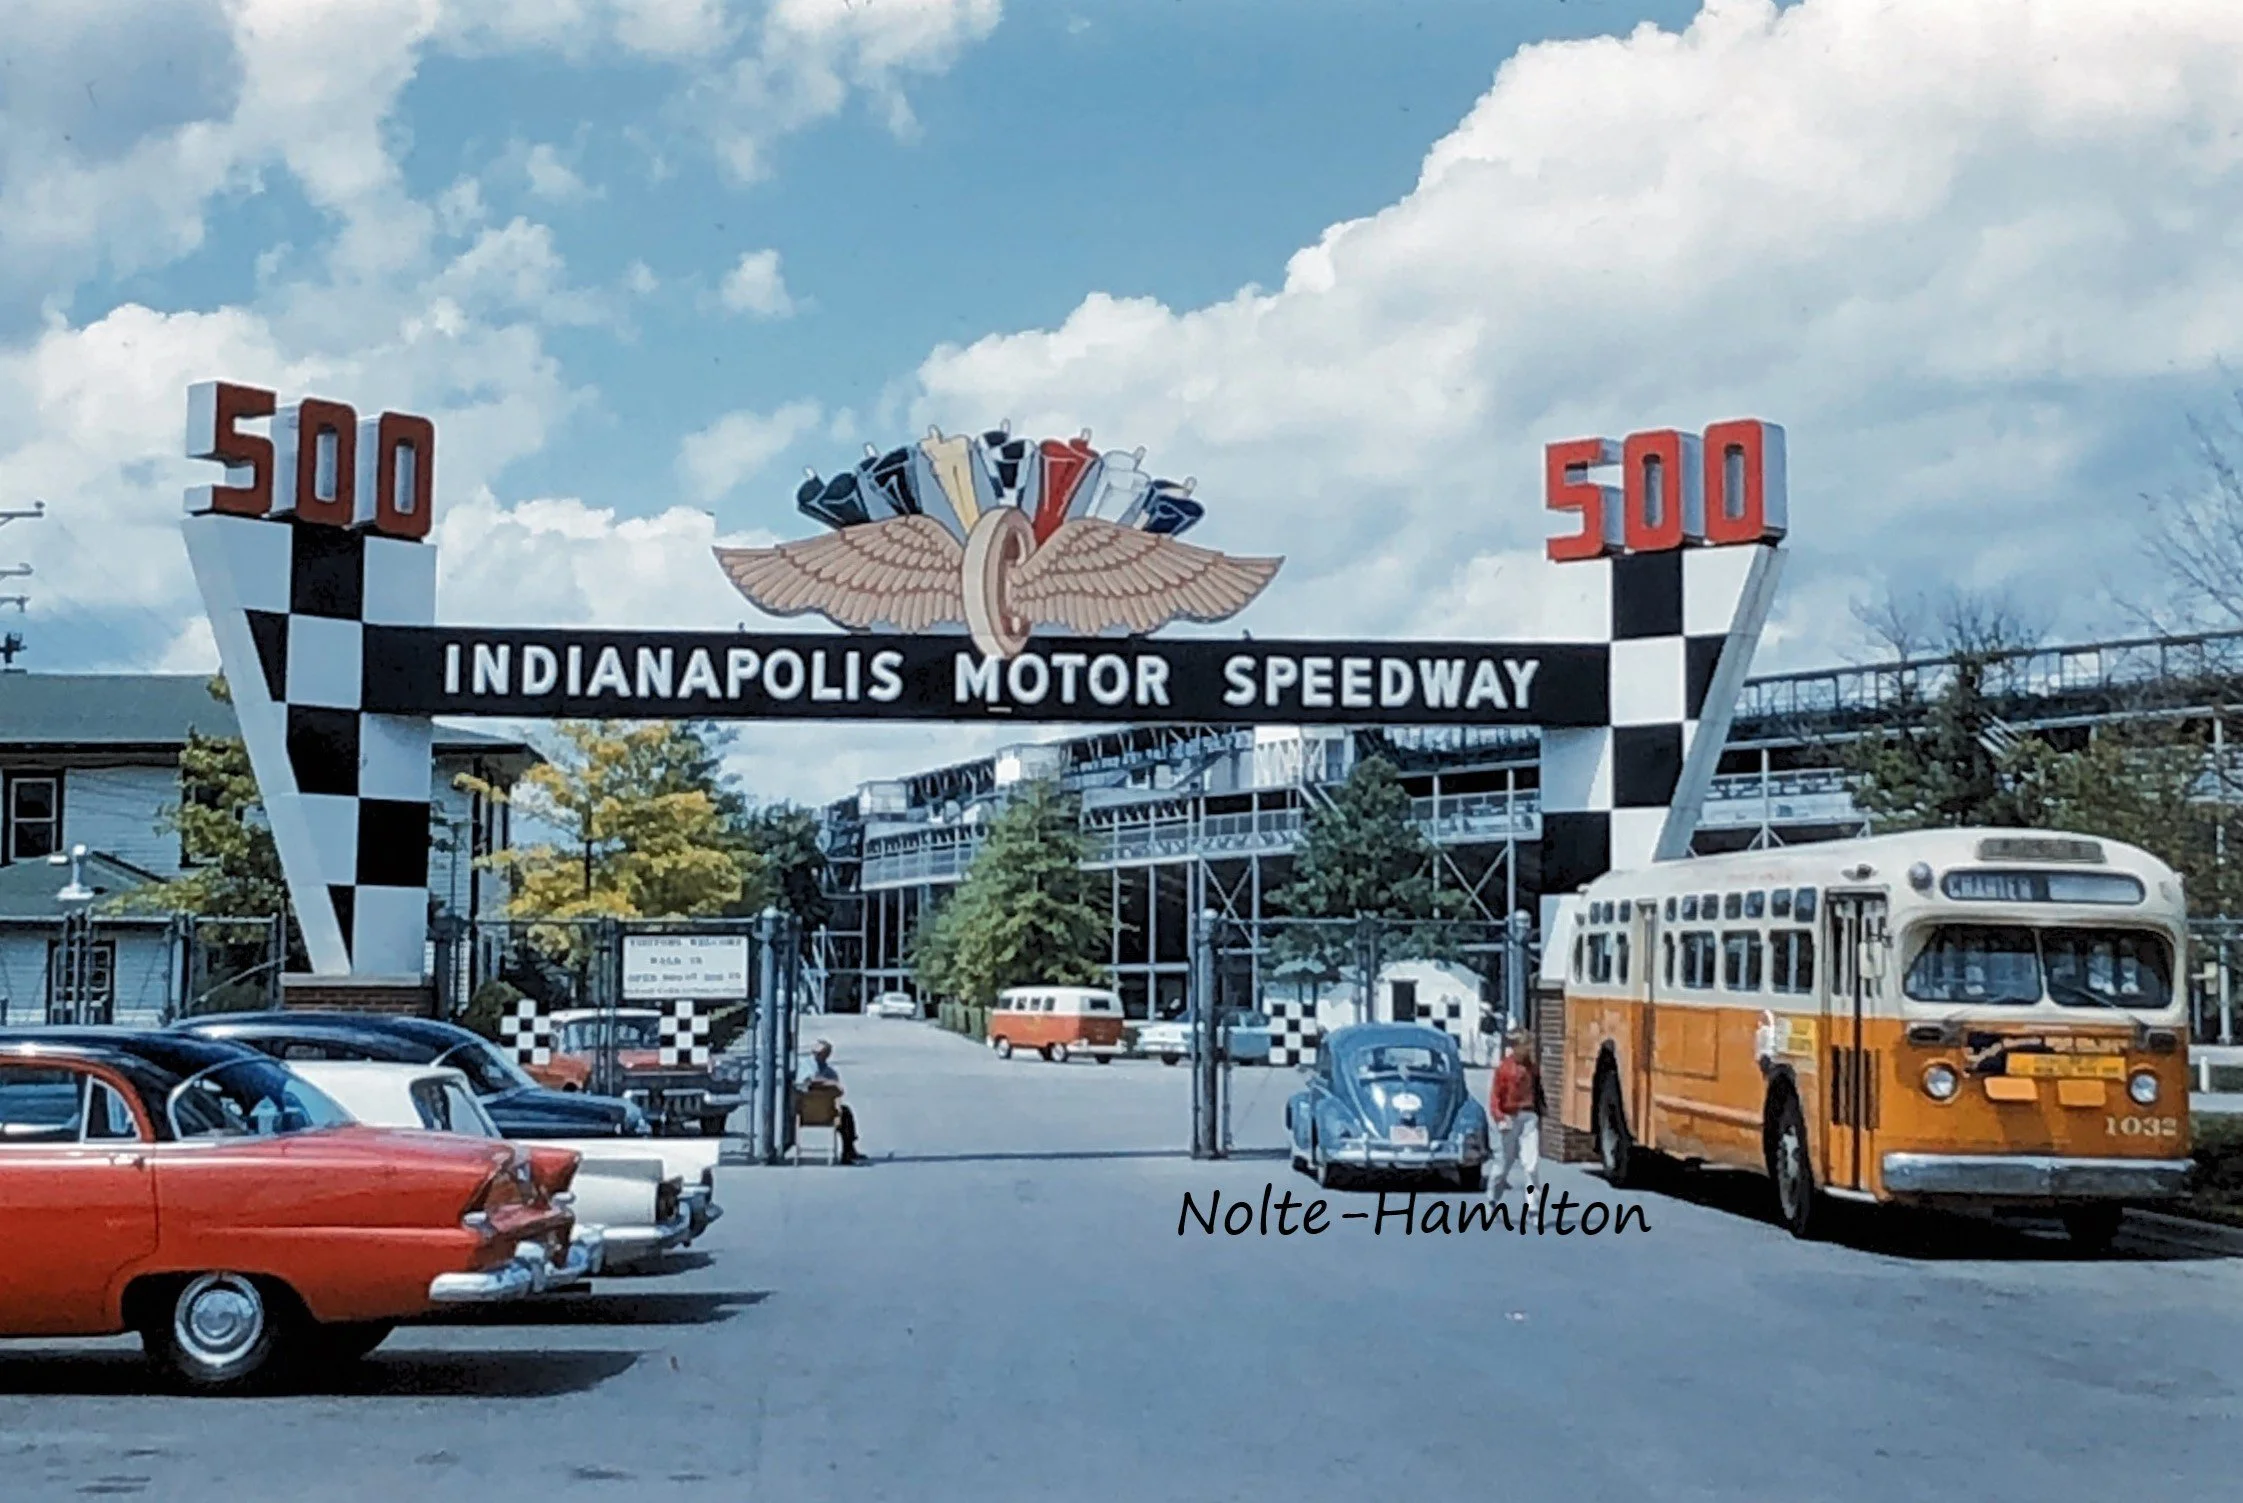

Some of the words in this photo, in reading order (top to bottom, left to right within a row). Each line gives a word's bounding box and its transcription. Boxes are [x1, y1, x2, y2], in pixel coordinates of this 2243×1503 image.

[210, 380, 435, 537] 500
[1545, 417, 1765, 562] 500
[444, 643, 904, 701] INDIANAPOLIS
[953, 652, 1171, 706] MOTOR
[1223, 655, 1540, 709] SPEEDWAY
